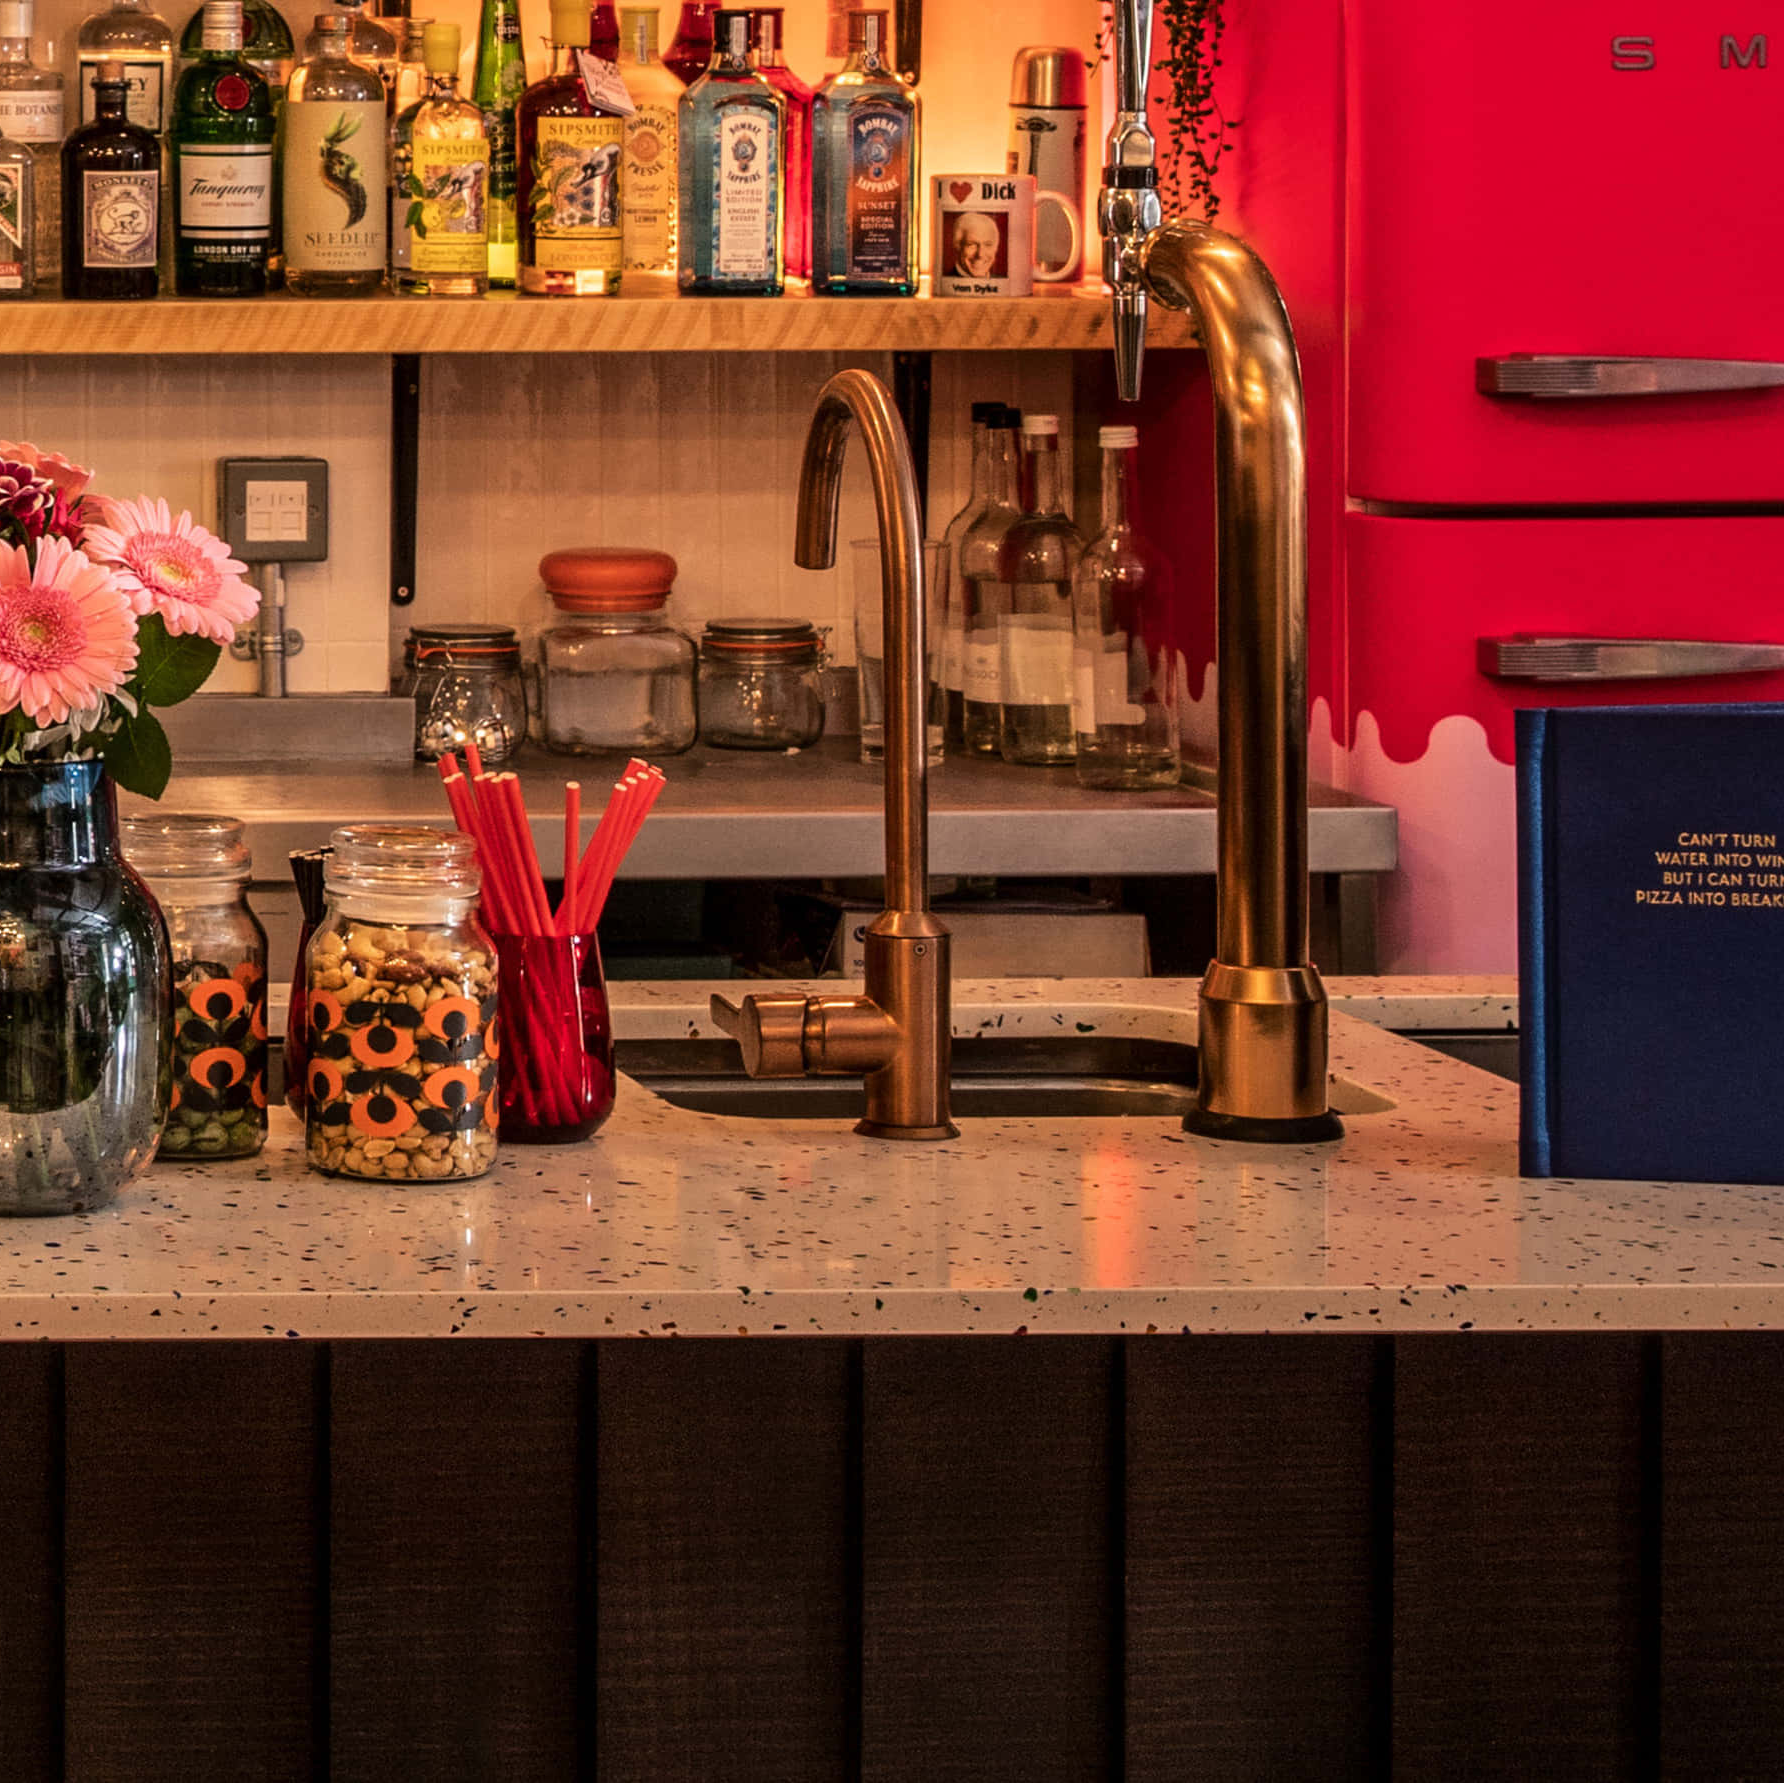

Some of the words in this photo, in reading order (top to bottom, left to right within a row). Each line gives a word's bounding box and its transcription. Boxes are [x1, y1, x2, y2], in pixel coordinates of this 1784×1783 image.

[549, 123, 620, 136] SIPSMITH
[627, 117, 666, 135] BOMBAY
[728, 122, 761, 136] BOMBAY
[857, 118, 900, 137] BOMBAY
[422, 144, 484, 155] SIPSMITH
[727, 171, 762, 184] SAPPHIRE
[854, 174, 900, 193] SAPPHIRE
[189, 178, 266, 199] Tanqueray
[981, 180, 1016, 200] Dick
[857, 201, 897, 210] SUNSET
[304, 231, 379, 248] SEEDLIP
[193, 244, 228, 253] LONDON
[230, 244, 247, 253] DRY
[0, 265, 17, 275] GIN
[952, 283, 971, 293] Van
[974, 283, 999, 295] Dyke
[1678, 832, 1729, 847] CAN'T
[1732, 833, 1776, 848] TURN
[1655, 852, 1709, 867] WATER
[1714, 853, 1752, 868] INTO
[1663, 871, 1693, 886] BUT
[1698, 872, 1703, 886] I
[1707, 872, 1743, 887] CAN
[1635, 891, 1683, 906] PIZZA
[1688, 891, 1727, 906] INTO
